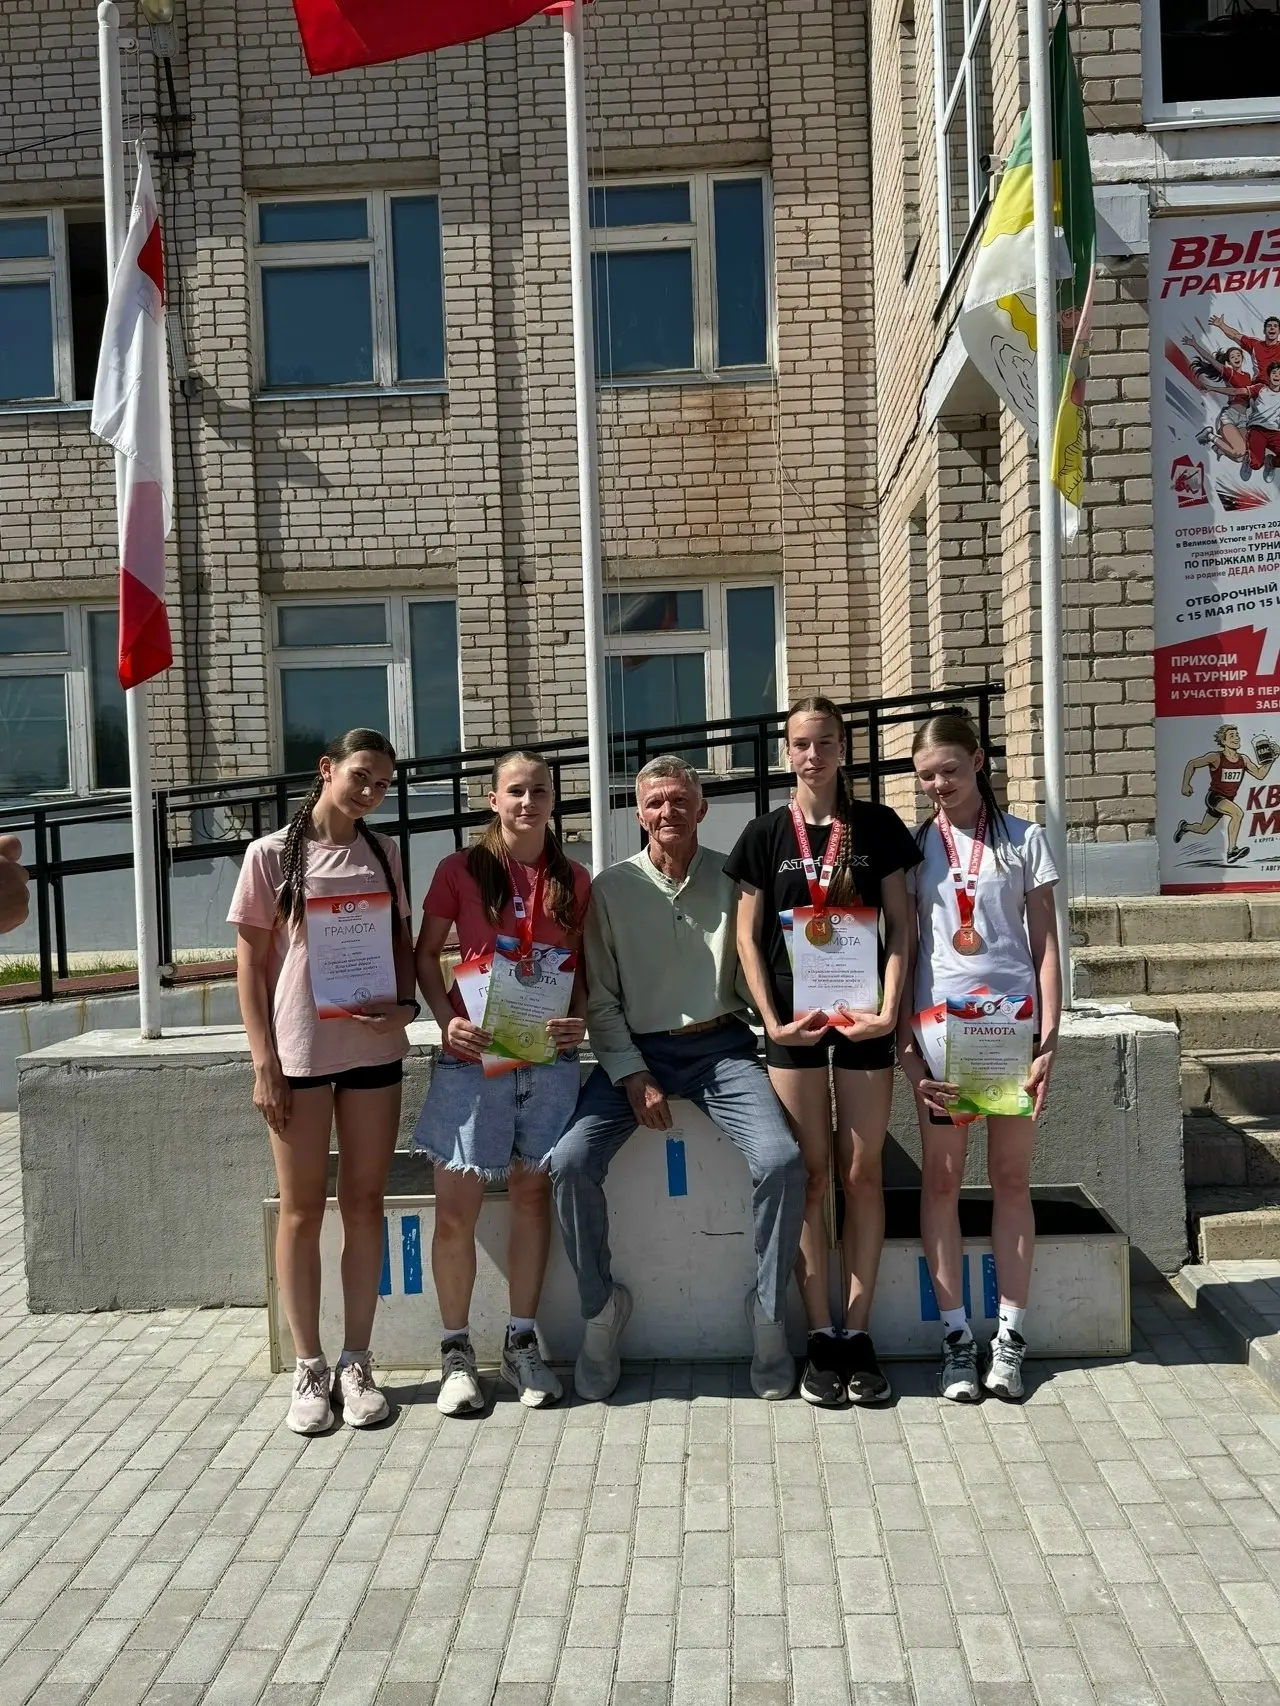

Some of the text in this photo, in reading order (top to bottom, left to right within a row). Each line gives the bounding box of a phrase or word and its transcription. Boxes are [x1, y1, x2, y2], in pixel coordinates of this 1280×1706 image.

[1168, 228, 1280, 271] ВЫЗ
[1175, 525, 1228, 538] ОТОРВИСЬ
[1236, 523, 1266, 532] августа
[1183, 539, 1218, 548] Великом
[1219, 535, 1247, 544] Устюге
[1191, 547, 1247, 559] грандиозного
[1184, 560, 1199, 569] ПО
[1202, 554, 1255, 568] ПРЫЖКАМ
[1258, 553, 1264, 562] В
[1196, 570, 1226, 580] родине
[1228, 566, 1255, 577] ДЕДА
[1258, 562, 1280, 573] МОР
[1186, 581, 1278, 608] ОТБОРОЧНЫЙ
[1176, 613, 1184, 623] С
[1188, 611, 1202, 621] 15
[1205, 604, 1233, 618] МАЯ
[1237, 600, 1256, 612] ПО
[1259, 597, 1273, 608] 15
[1171, 653, 1237, 667] ПРИХОДИ
[1172, 670, 1248, 684] НА ТУРНИР
[1171, 686, 1280, 700] И УЧАСТВУЙ В ПЕР
[1256, 699, 1280, 709] ЗАБ
[1223, 771, 1241, 780] 1877
[825, 833, 839, 864] ОБЛАСТЬ
[324, 922, 377, 937] ГРАМОТА
[508, 968, 557, 986] ГОТА
[964, 1026, 1016, 1035] ГРАМОТА
